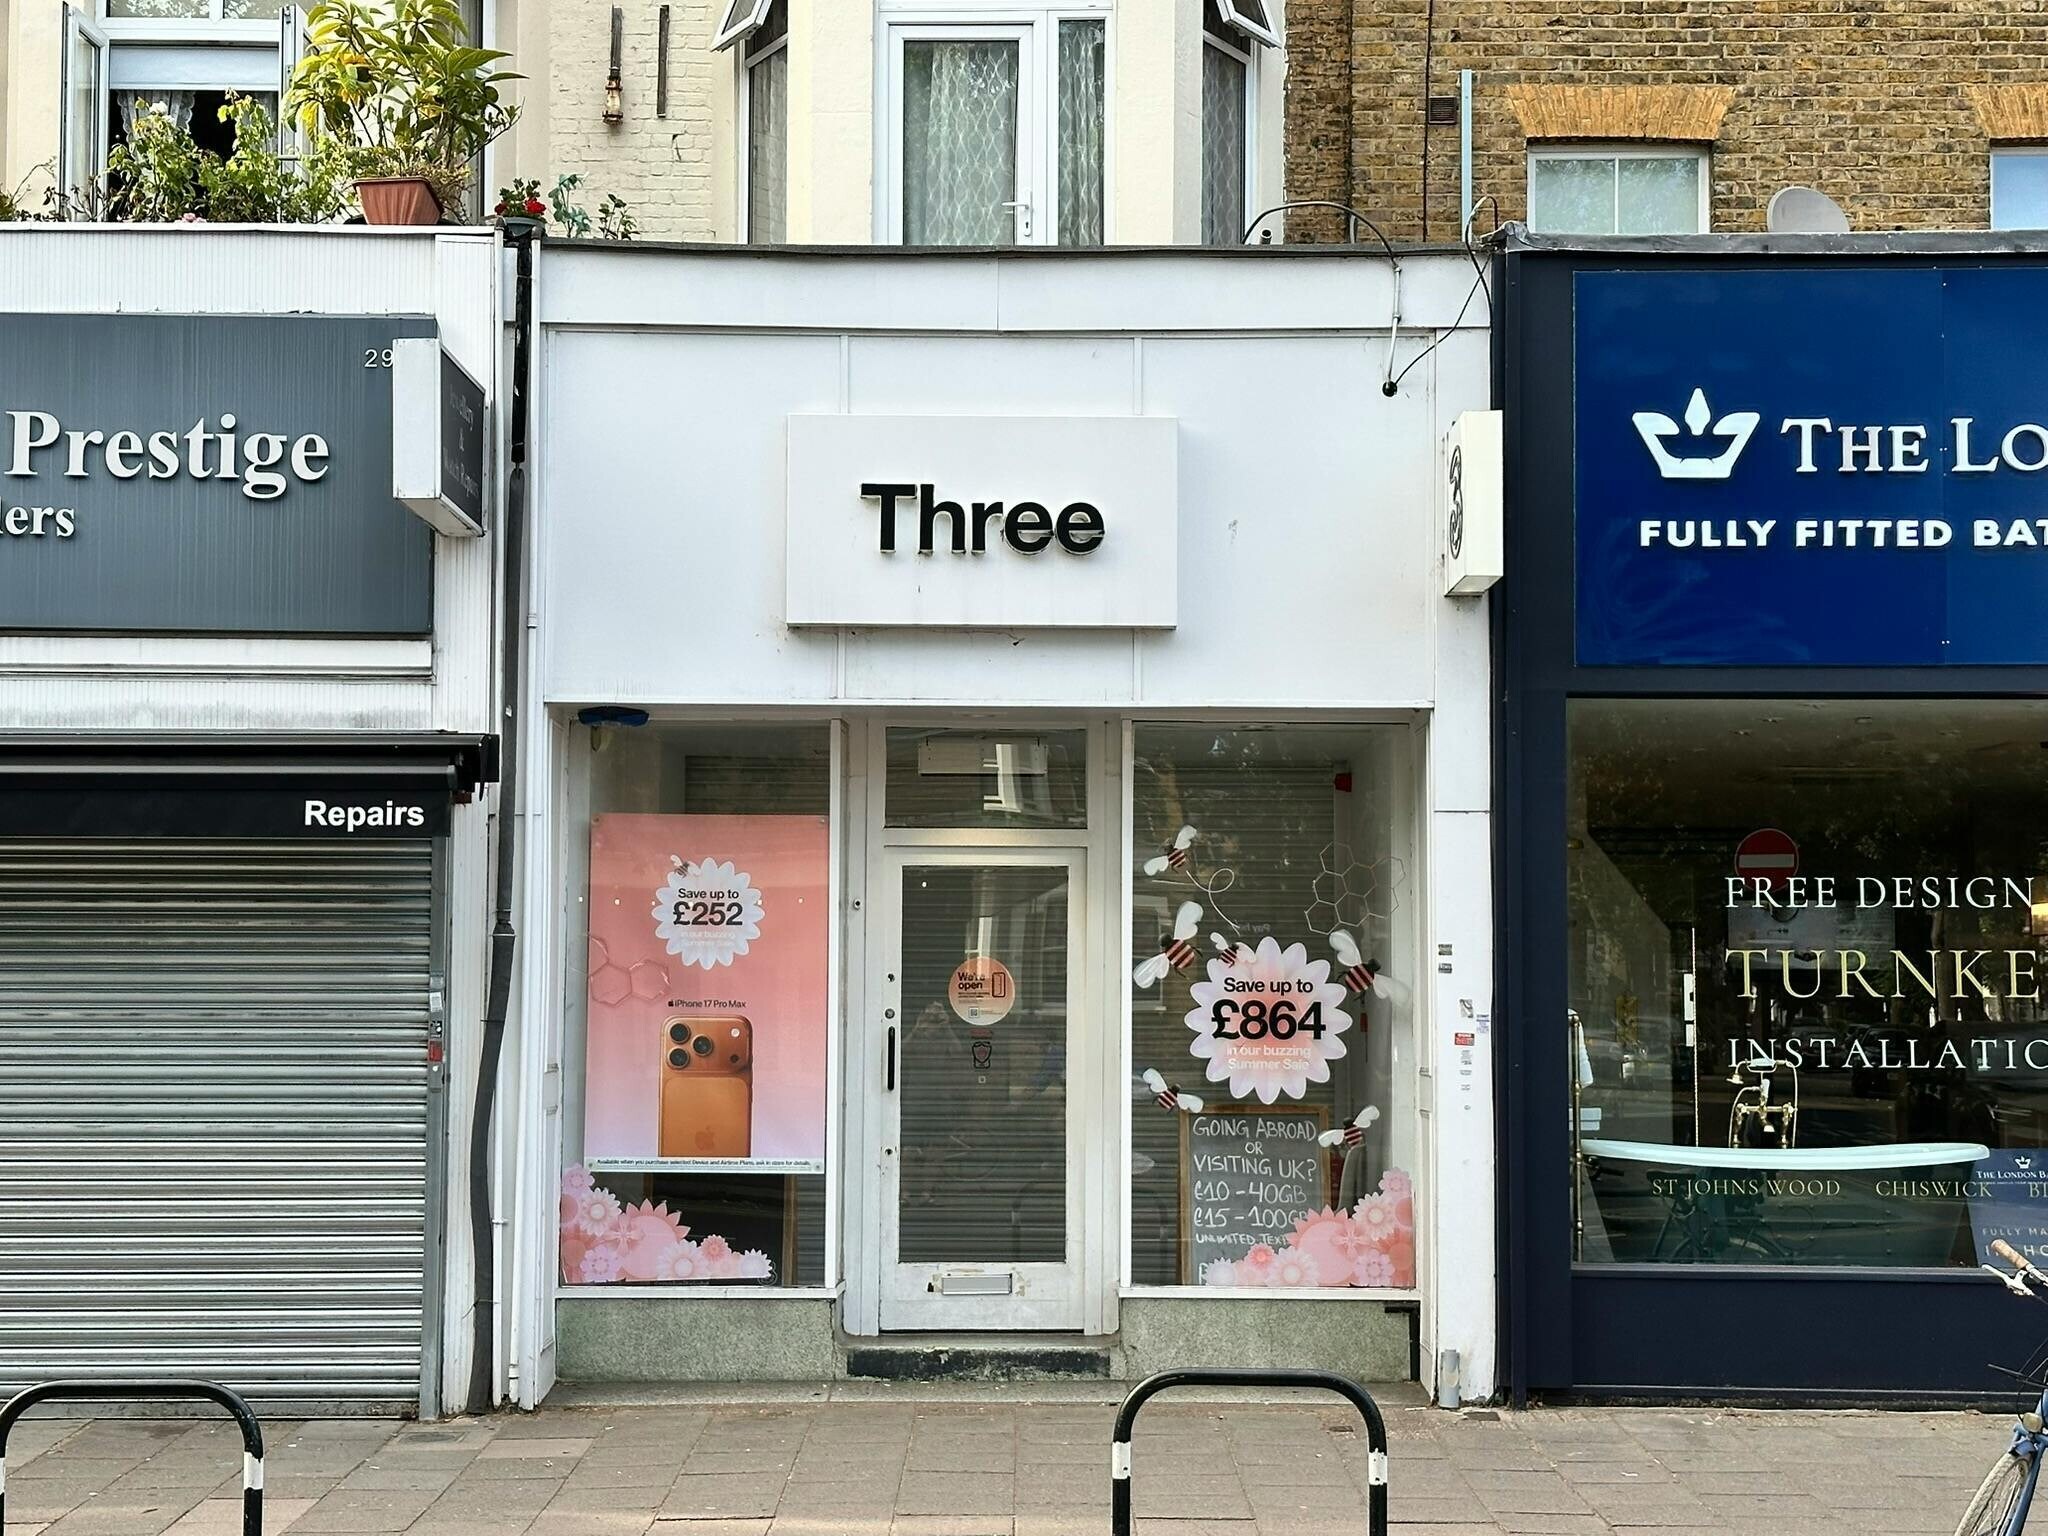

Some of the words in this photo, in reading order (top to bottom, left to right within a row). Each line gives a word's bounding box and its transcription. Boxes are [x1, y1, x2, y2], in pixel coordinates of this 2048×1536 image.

[4, 411, 330, 499] Prestige
[1780, 417, 1929, 473] THE
[0, 496, 75, 537] ers
[859, 482, 1105, 556] Three
[1640, 519, 1776, 547] FULLY
[1795, 519, 1953, 547] FITTED
[304, 800, 425, 832] Repairs
[678, 888, 706, 899] Save
[710, 890, 725, 900] up
[727, 889, 740, 899] to
[1724, 876, 1837, 909] FREE
[1856, 875, 2034, 910] DESIGN
[673, 900, 743, 925] £252
[1725, 948, 2048, 1000] TURNKE
[958, 982, 983, 990] open
[1223, 977, 1265, 993] Save
[1270, 980, 1292, 996] up
[1296, 979, 1314, 993] to
[674, 1000, 702, 1008] iPhone
[713, 1000, 727, 1008] Pro
[729, 1000, 746, 1008] Max
[1211, 999, 1326, 1040] £864
[1263, 1044, 1311, 1059] buzzing
[1228, 1058, 1279, 1070] Summer
[1193, 1116, 1249, 1138] GOING
[1256, 1117, 1317, 1142] ABROAD
[1244, 1141, 1264, 1155] OR
[1193, 1154, 1272, 1177] VISITING
[1278, 1158, 1317, 1182] UK?
[1976, 1170, 1996, 1179] THE
[1997, 1170, 2037, 1179] LONDON
[2038, 1170, 2048, 1179] B
[1652, 1179, 1678, 1196] ST
[1684, 1179, 1759, 1200] JOHNS
[1767, 1179, 1841, 1197] WOOD
[1875, 1180, 1993, 1198] CHISWICK
[1195, 1232, 1256, 1245] UNLIMITED
[1982, 1226, 2021, 1236] FULLY
